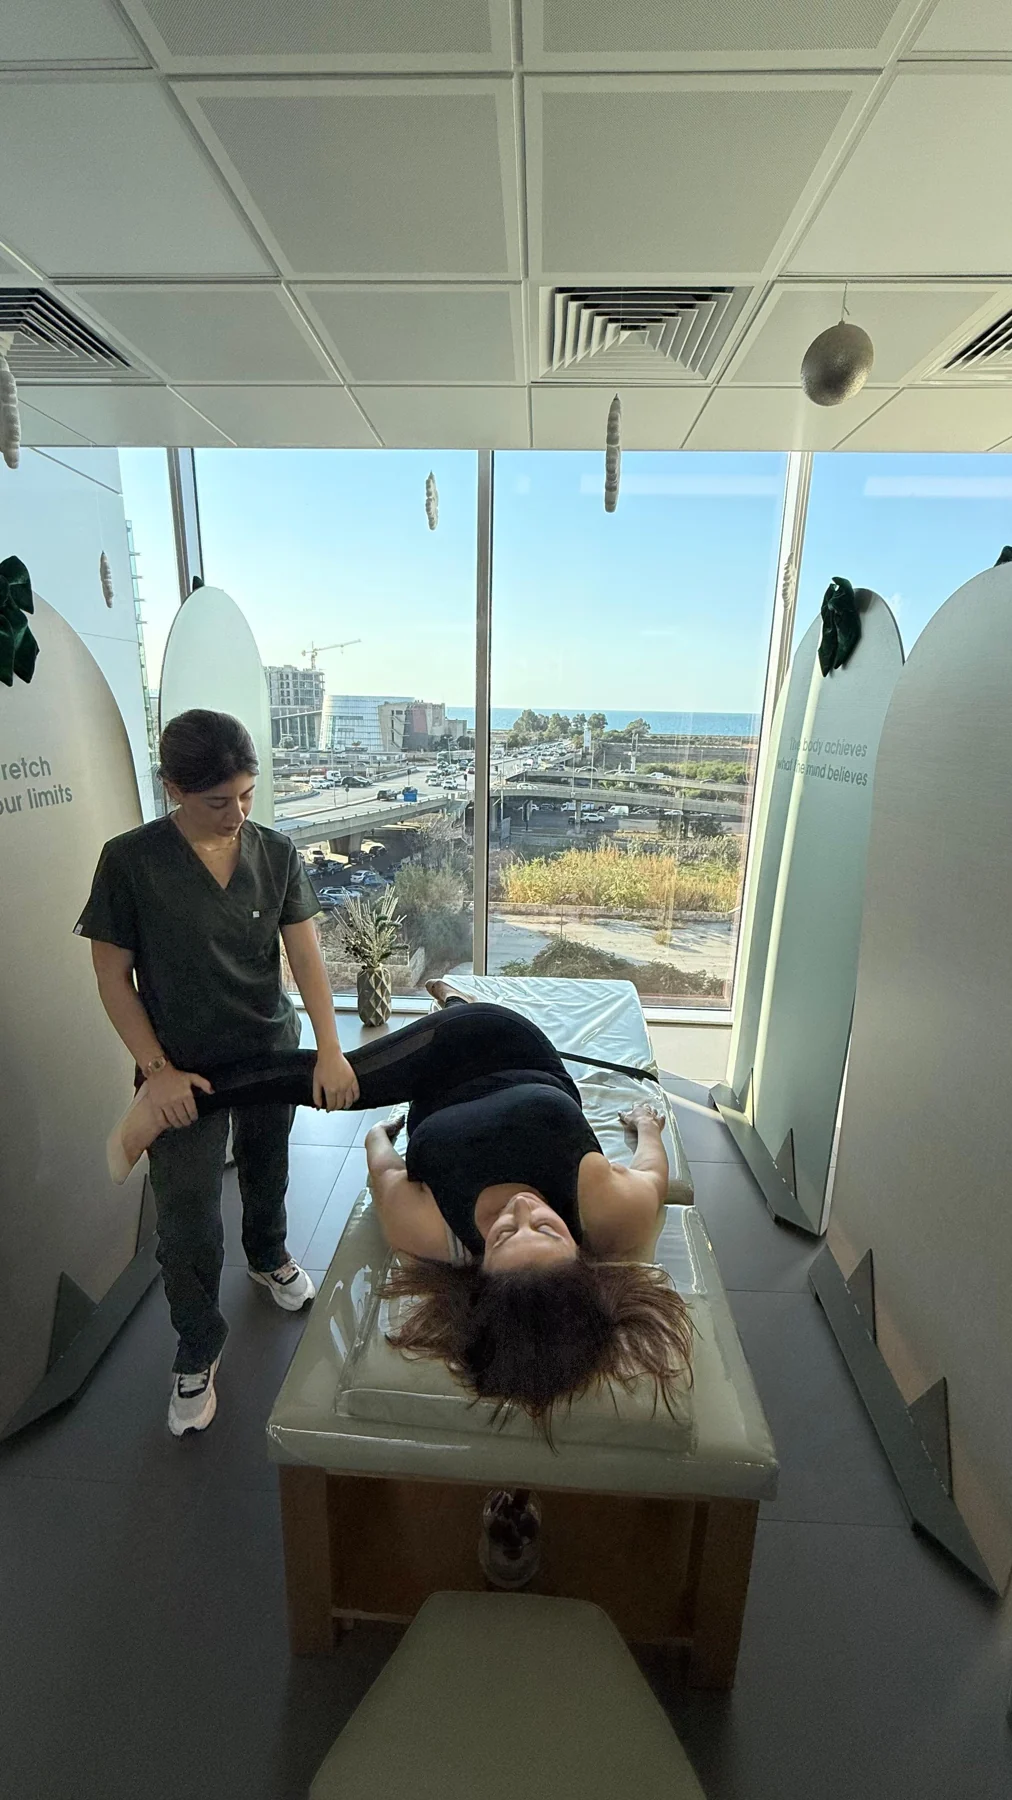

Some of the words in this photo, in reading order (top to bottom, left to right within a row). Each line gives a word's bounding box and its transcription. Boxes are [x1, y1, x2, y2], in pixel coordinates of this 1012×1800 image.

[802, 737, 823, 755] body
[824, 739, 868, 757] achieves
[805, 764, 827, 778] mind
[827, 764, 868, 786] believes
[27, 784, 73, 809] limits
